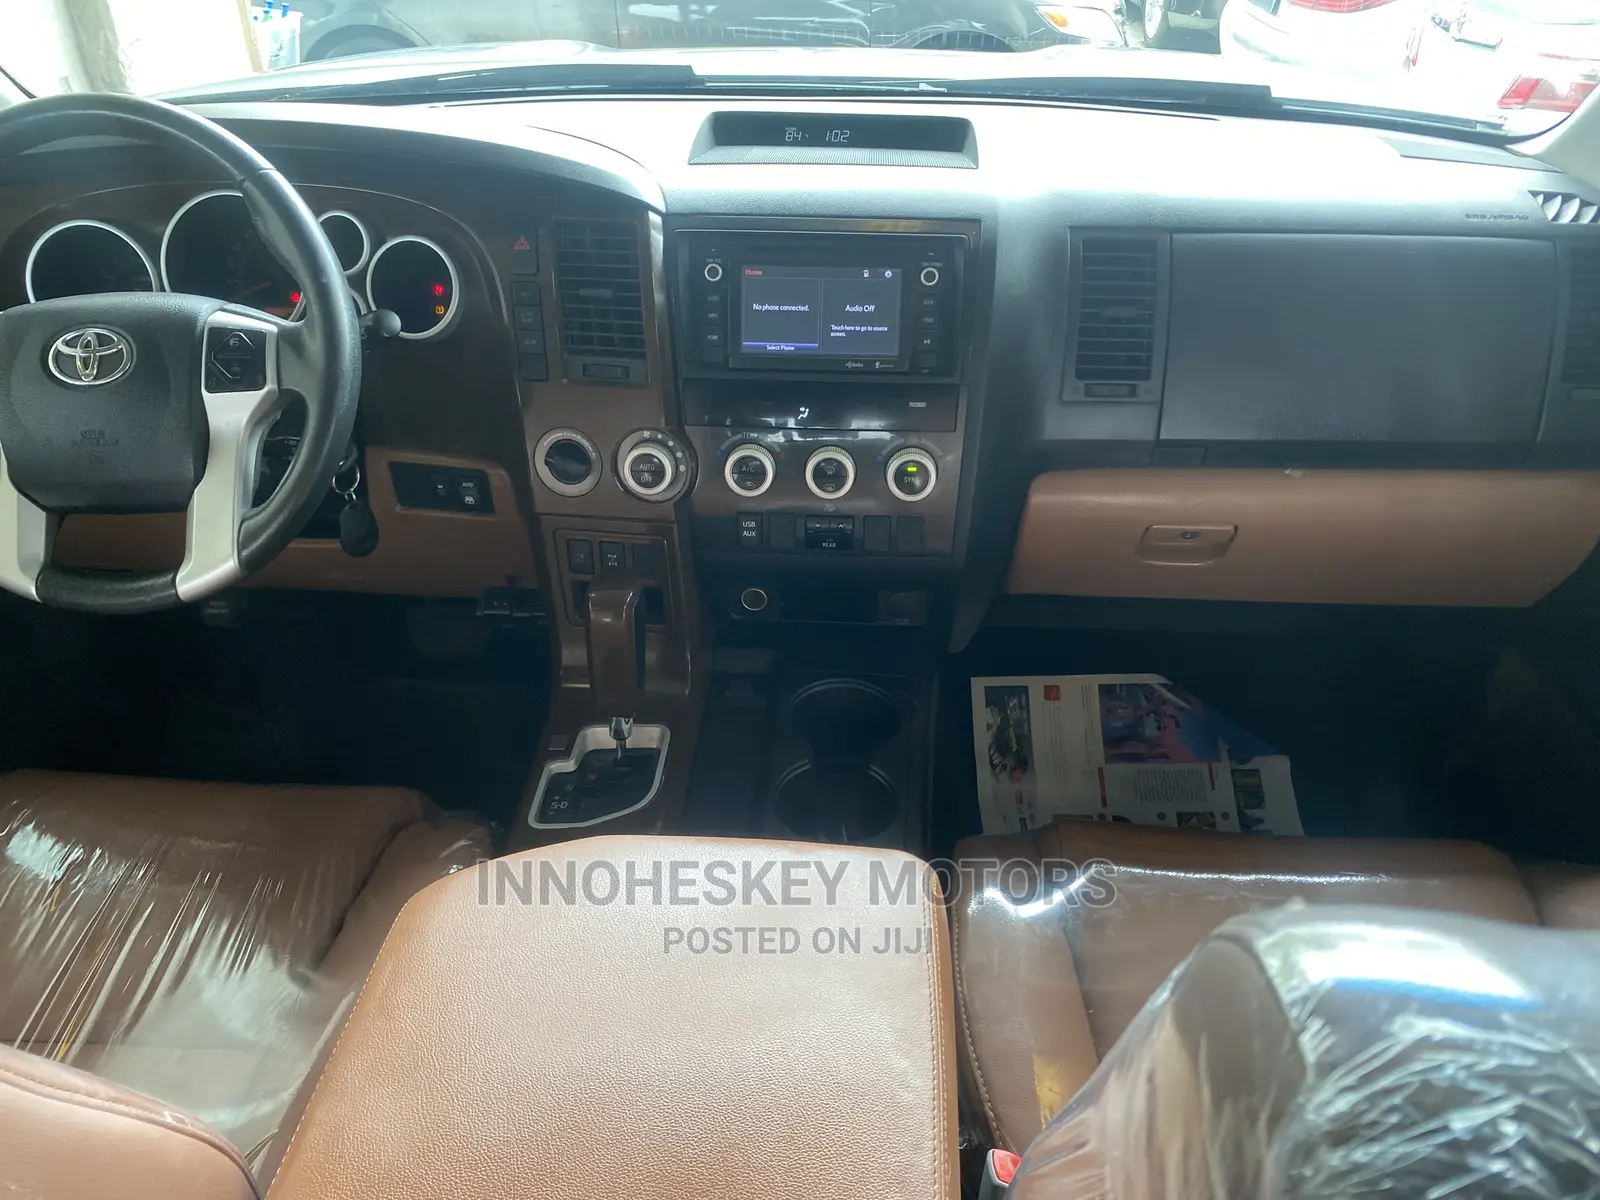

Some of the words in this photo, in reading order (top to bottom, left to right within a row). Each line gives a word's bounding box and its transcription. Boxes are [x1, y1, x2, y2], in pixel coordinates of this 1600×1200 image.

[785, 130, 802, 142] 84
[825, 129, 851, 143] 1:02
[745, 268, 763, 276] Home
[752, 303, 762, 311] No
[762, 304, 780, 312] phone
[780, 304, 810, 312] connected.
[845, 304, 863, 313] Audio
[864, 304, 876, 313] Off
[830, 324, 844, 332] Touch
[845, 324, 855, 332] here
[639, 463, 656, 471] AUTO
